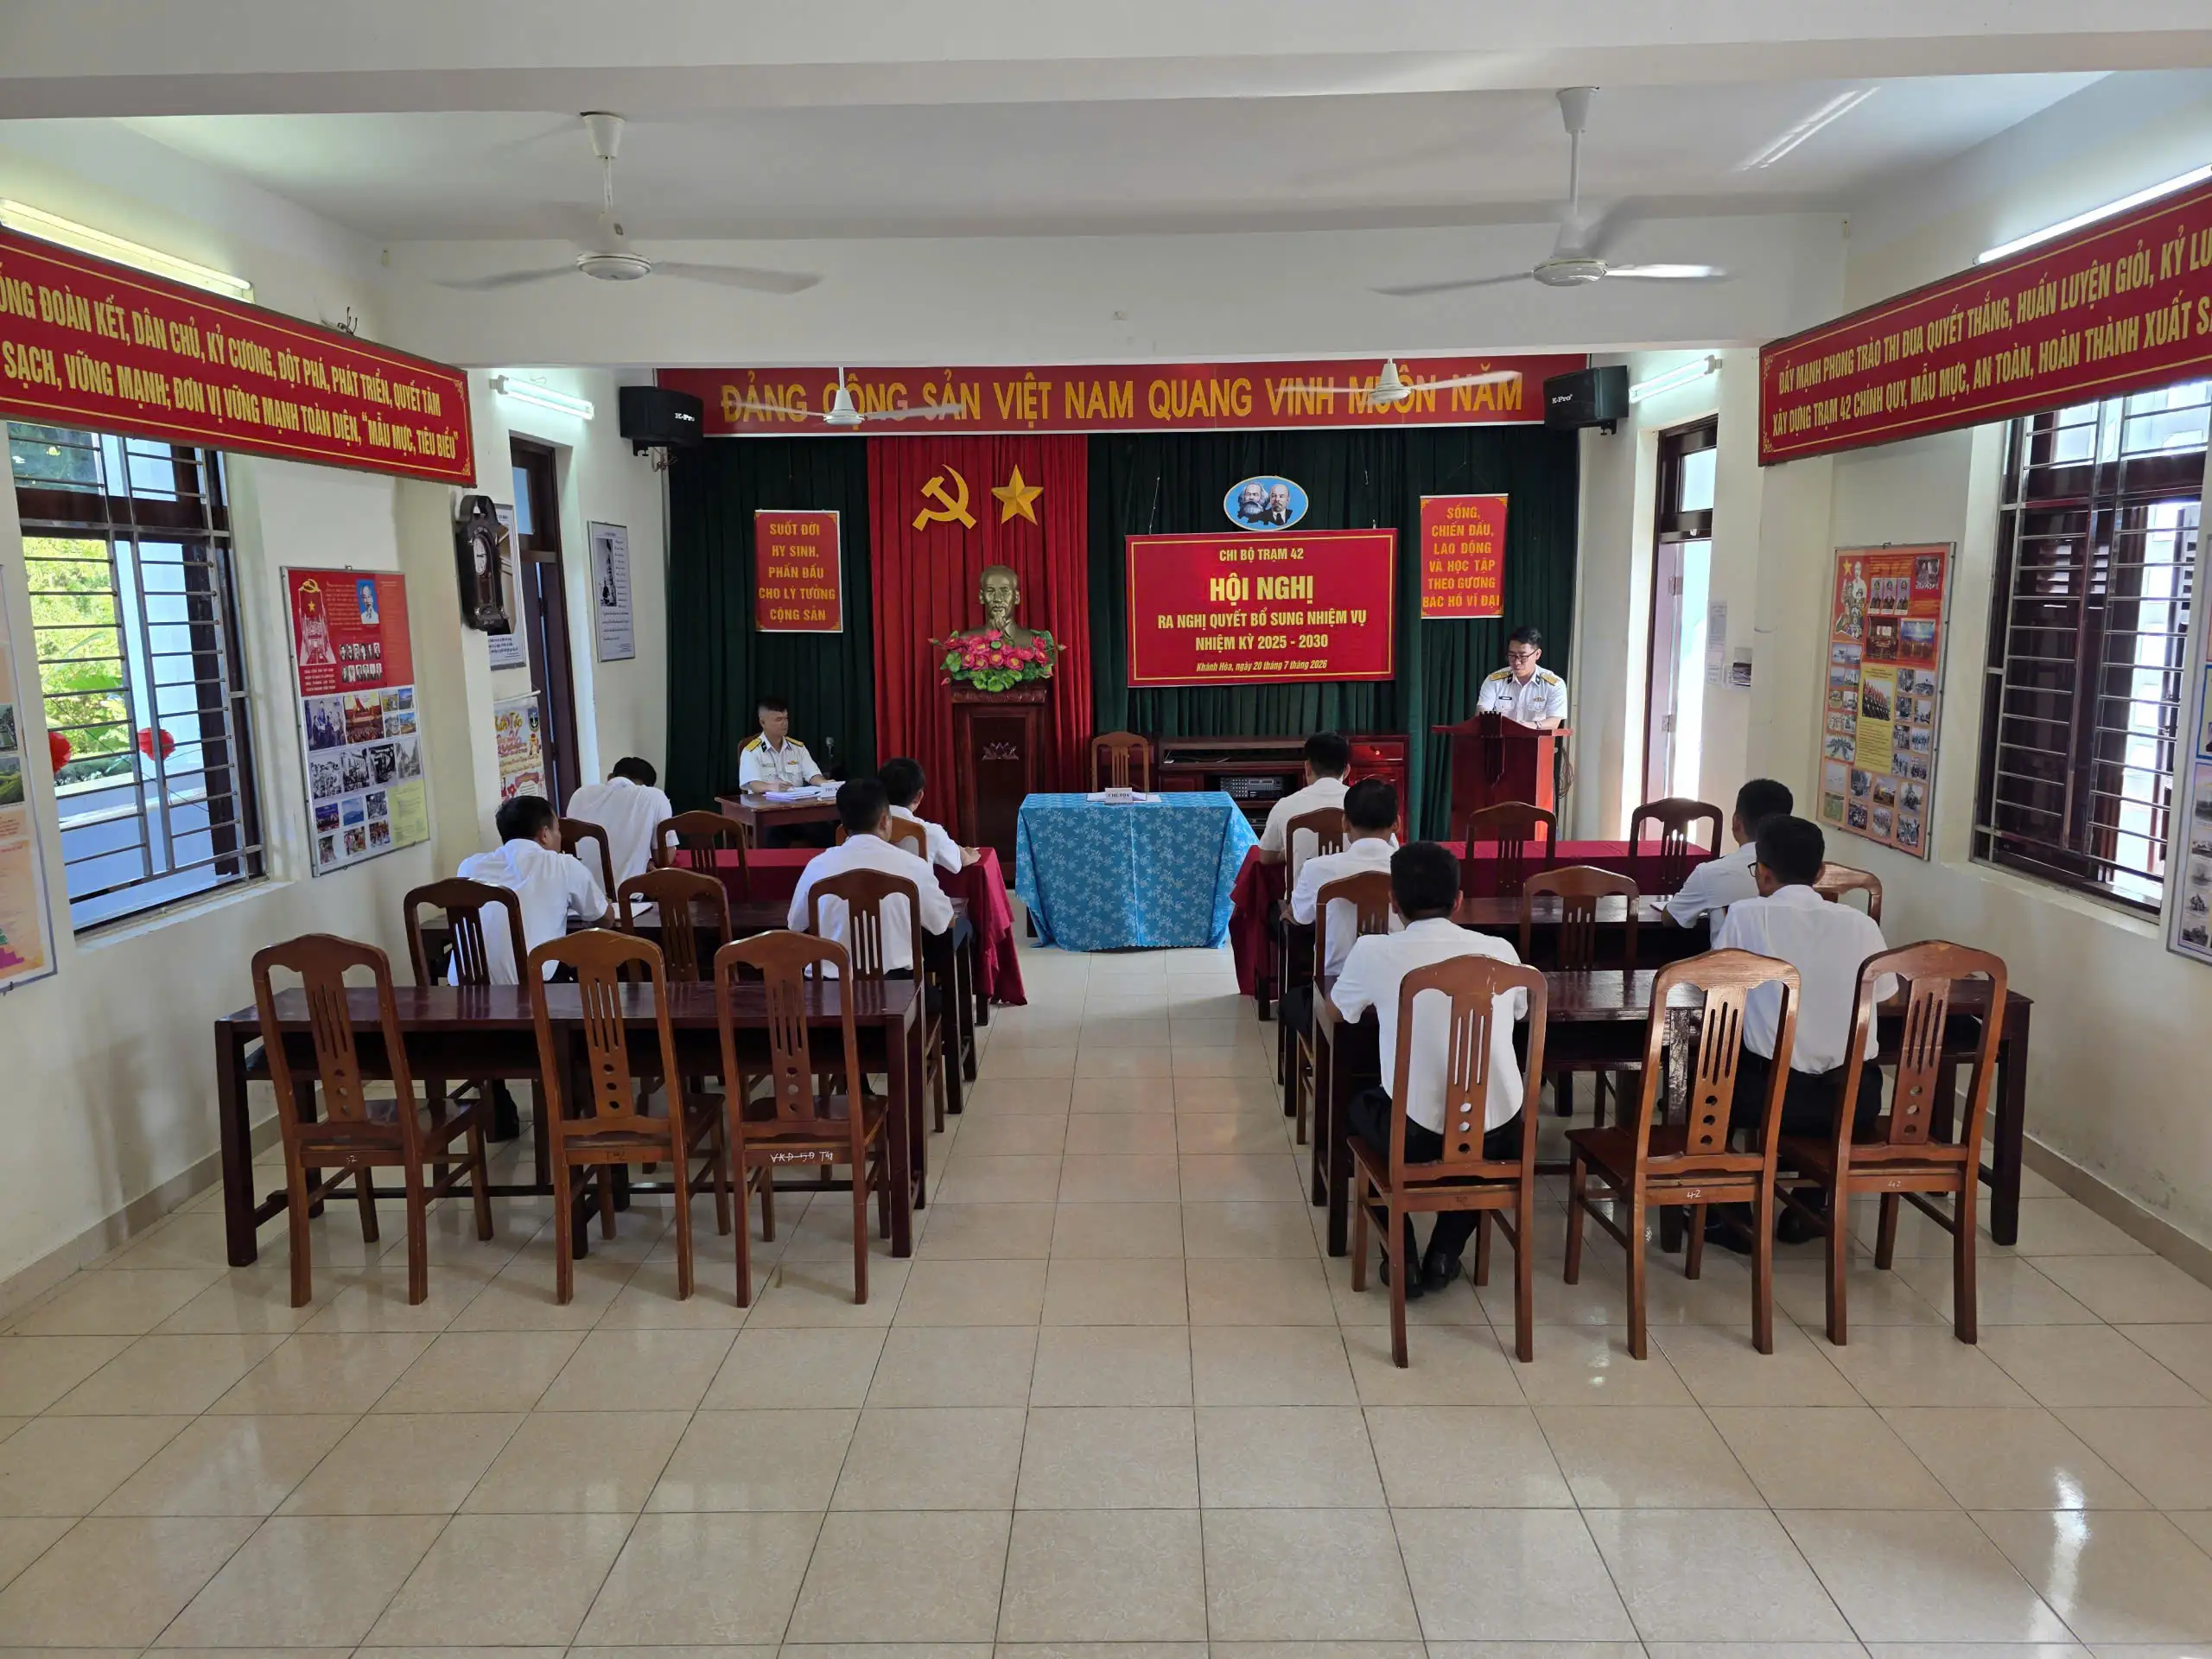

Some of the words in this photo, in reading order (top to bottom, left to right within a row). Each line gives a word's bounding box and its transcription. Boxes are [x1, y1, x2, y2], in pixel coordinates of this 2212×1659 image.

[1778, 359, 1796, 395] ĐẨY
[1796, 359, 1821, 393] MẠNH
[1823, 348, 1854, 382] PHONG
[1857, 336, 1881, 372] TRÀO
[1884, 333, 1899, 364] THI
[1902, 325, 1923, 359] ĐUA
[1927, 304, 1965, 353] QUYẾT
[1967, 290, 2013, 339] THẮNG,
[2017, 272, 2057, 324] HUẤN
[2061, 259, 2111, 310] LUYỆN
[2115, 238, 2155, 295] GIỎI,
[2160, 225, 2186, 281] KỶ
[38, 285, 92, 333] ĐOÀN
[93, 294, 130, 346] KẾT,
[132, 307, 168, 351] DÂN
[169, 315, 206, 364] CHỦ,
[206, 323, 225, 365] KỶ
[228, 337, 276, 381] CƯƠNG,
[277, 347, 301, 389] ĐỘT
[302, 356, 331, 395] PHÁ,
[331, 364, 359, 397] PHÁT
[359, 367, 393, 408] TRIỂN,
[393, 379, 422, 412] QUYẾT
[422, 386, 442, 417] TÂM
[1772, 408, 1788, 436] XÂY
[1789, 404, 1811, 437] DỰNG
[1814, 397, 1838, 430] TRẠM
[1840, 394, 1852, 421] 42
[1853, 383, 1884, 418] CHÍNH
[1885, 379, 1908, 413] QUY,
[1910, 362, 1936, 405] MẪU
[1939, 361, 1970, 402] MỰC,
[1973, 356, 1992, 390] AN
[1995, 342, 2034, 385] TOÀN,
[2037, 329, 2081, 374] HOÀN
[2085, 315, 2139, 363] THÀNH
[2143, 289, 2192, 349] XUẤT
[2, 340, 62, 391] SẠCH,
[64, 349, 114, 397] VỮNG
[116, 365, 171, 410] MẠNH;
[173, 376, 206, 414] ĐƠN
[206, 384, 223, 423] VỊ
[223, 384, 260, 424] VỮNG
[261, 396, 300, 435] MẠNH
[301, 402, 331, 437] TOÀN
[332, 409, 362, 447] DIỆN,
[391, 424, 416, 457] MỰC,
[416, 426, 435, 457] TIÊU
[721, 371, 808, 423] ĐẢNG
[922, 368, 980, 422] SẢN
[994, 372, 1052, 429] VIỆT
[1065, 380, 1134, 419] NAM
[1148, 378, 1252, 422] QUANG
[1265, 377, 1334, 417] VINH
[1452, 362, 1522, 412] NĂM
[769, 518, 798, 536] SUỐT
[801, 522, 820, 536] ĐỜI
[1432, 520, 1465, 537] CHIẾN
[772, 545, 785, 556] HY
[1219, 550, 1237, 562] CHI
[1240, 547, 1255, 563] BỘ
[1257, 548, 1287, 562] TRẠM
[1290, 548, 1304, 560] 42
[1434, 543, 1455, 555] LAO
[1461, 540, 1491, 556] ĐỘNG
[768, 563, 798, 578] PHẤN
[802, 563, 824, 578] ĐẤU
[1429, 558, 1442, 572] VÀ
[1448, 560, 1469, 574] HỌC
[1475, 557, 1495, 574] TẬP
[1210, 572, 1249, 606] HỘI
[1256, 575, 1313, 605] NGHỊ
[1428, 578, 1454, 589] THEO
[1458, 576, 1496, 588] GƯƠNG
[759, 588, 780, 599] CHO
[784, 586, 796, 600] LÝ
[800, 584, 836, 600] TƯỞNG
[1448, 592, 1463, 607] HỒ
[1481, 594, 1500, 608] ĐẠI
[770, 607, 799, 623] CỘNG
[804, 605, 826, 620] SẢN
[1158, 615, 1173, 629] RA
[1177, 614, 1206, 631] NGHỊ
[1210, 608, 1248, 629] QUYẾT
[1250, 607, 1268, 626] BỔ
[1270, 611, 1304, 626] SUNG
[1307, 607, 1347, 627] NHIỆM
[1351, 609, 1367, 626] VỤ
[1195, 633, 1236, 653] NHIỆM
[1238, 632, 1255, 651] KỲ
[1257, 635, 1287, 650] 2025
[1299, 634, 1328, 648] 2030
[1196, 662, 1217, 672] Khánh
[1218, 662, 1234, 672] Hòa,
[1235, 661, 1252, 672] ngày
[1253, 661, 1262, 671] 20
[1263, 660, 1282, 671] tháng
[1284, 660, 1289, 670] 7
[1290, 660, 1309, 671] tháng
[1309, 659, 1328, 670] 2026
